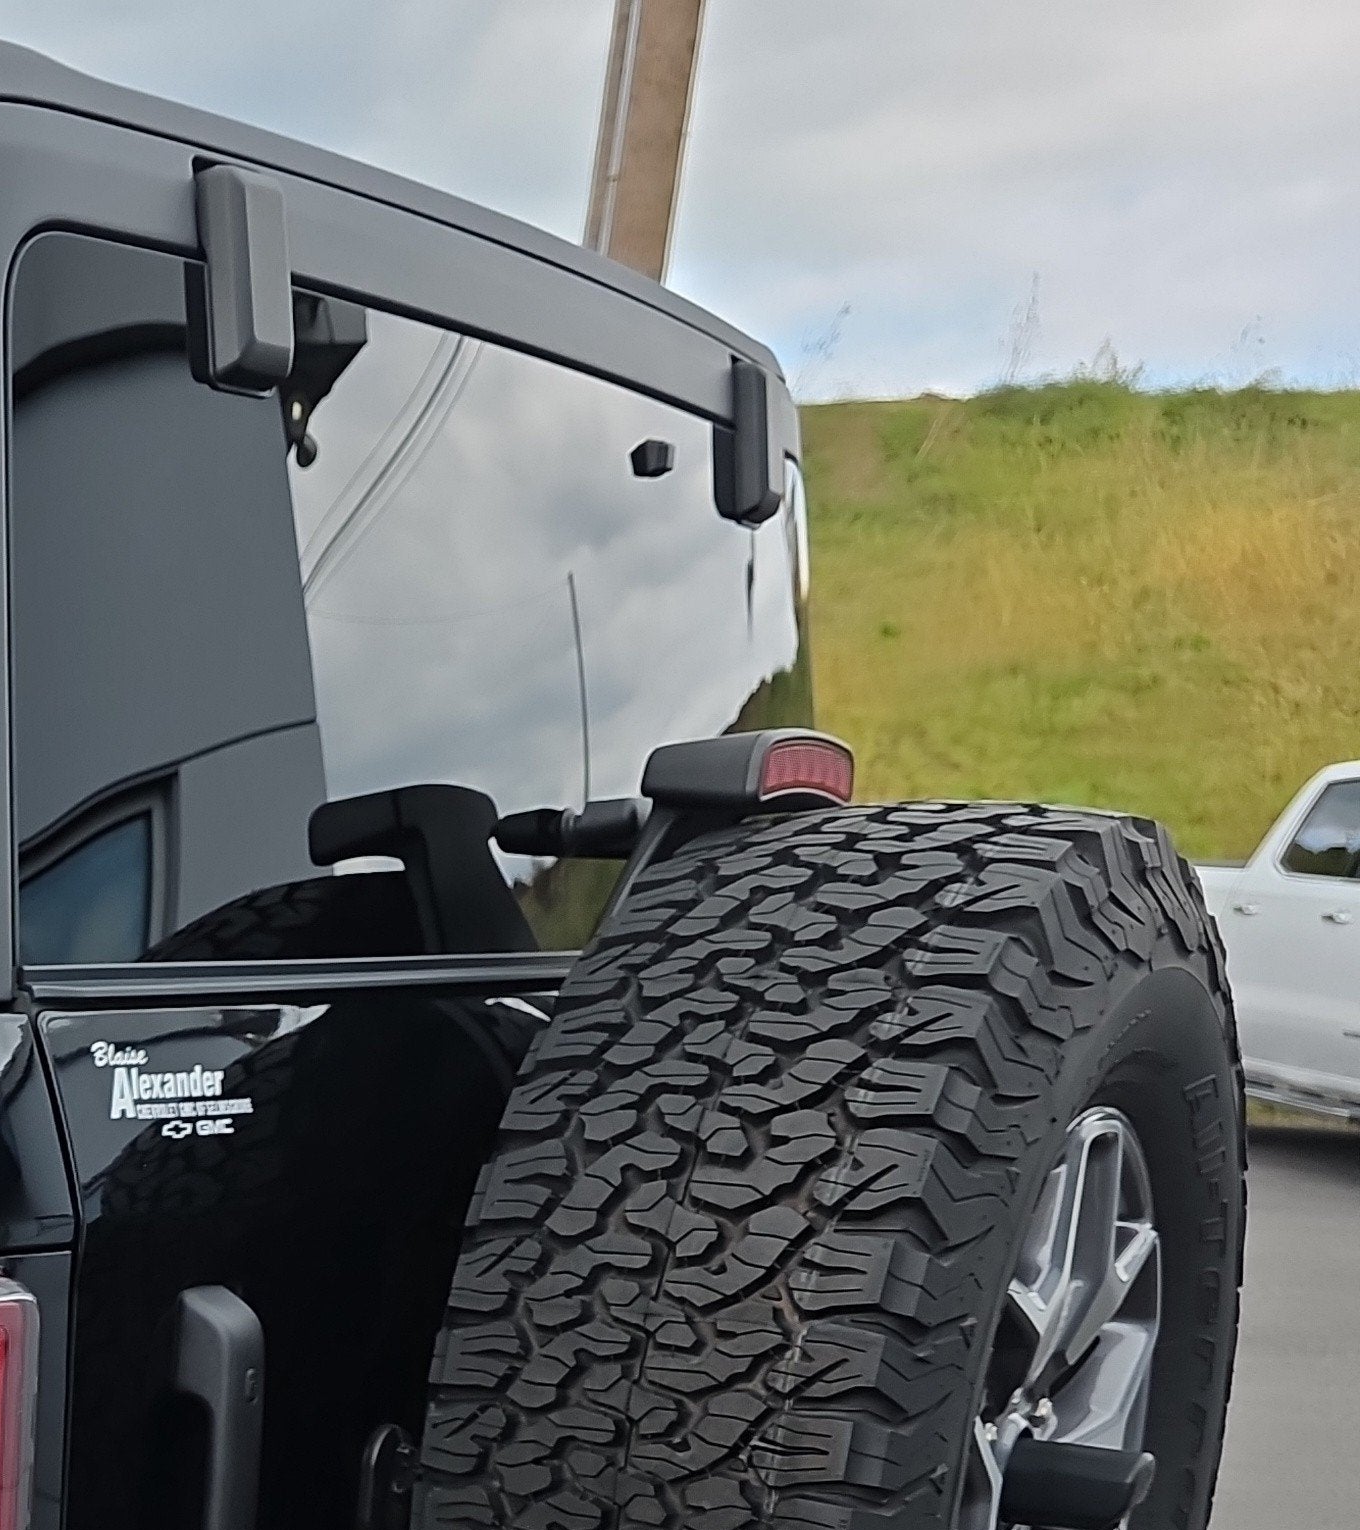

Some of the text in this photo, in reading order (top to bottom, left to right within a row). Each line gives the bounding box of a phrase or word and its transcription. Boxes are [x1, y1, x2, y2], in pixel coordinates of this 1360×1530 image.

[90, 1040, 149, 1067] Blaise
[110, 1064, 225, 1119] Alexander
[195, 1118, 235, 1136] GMC
